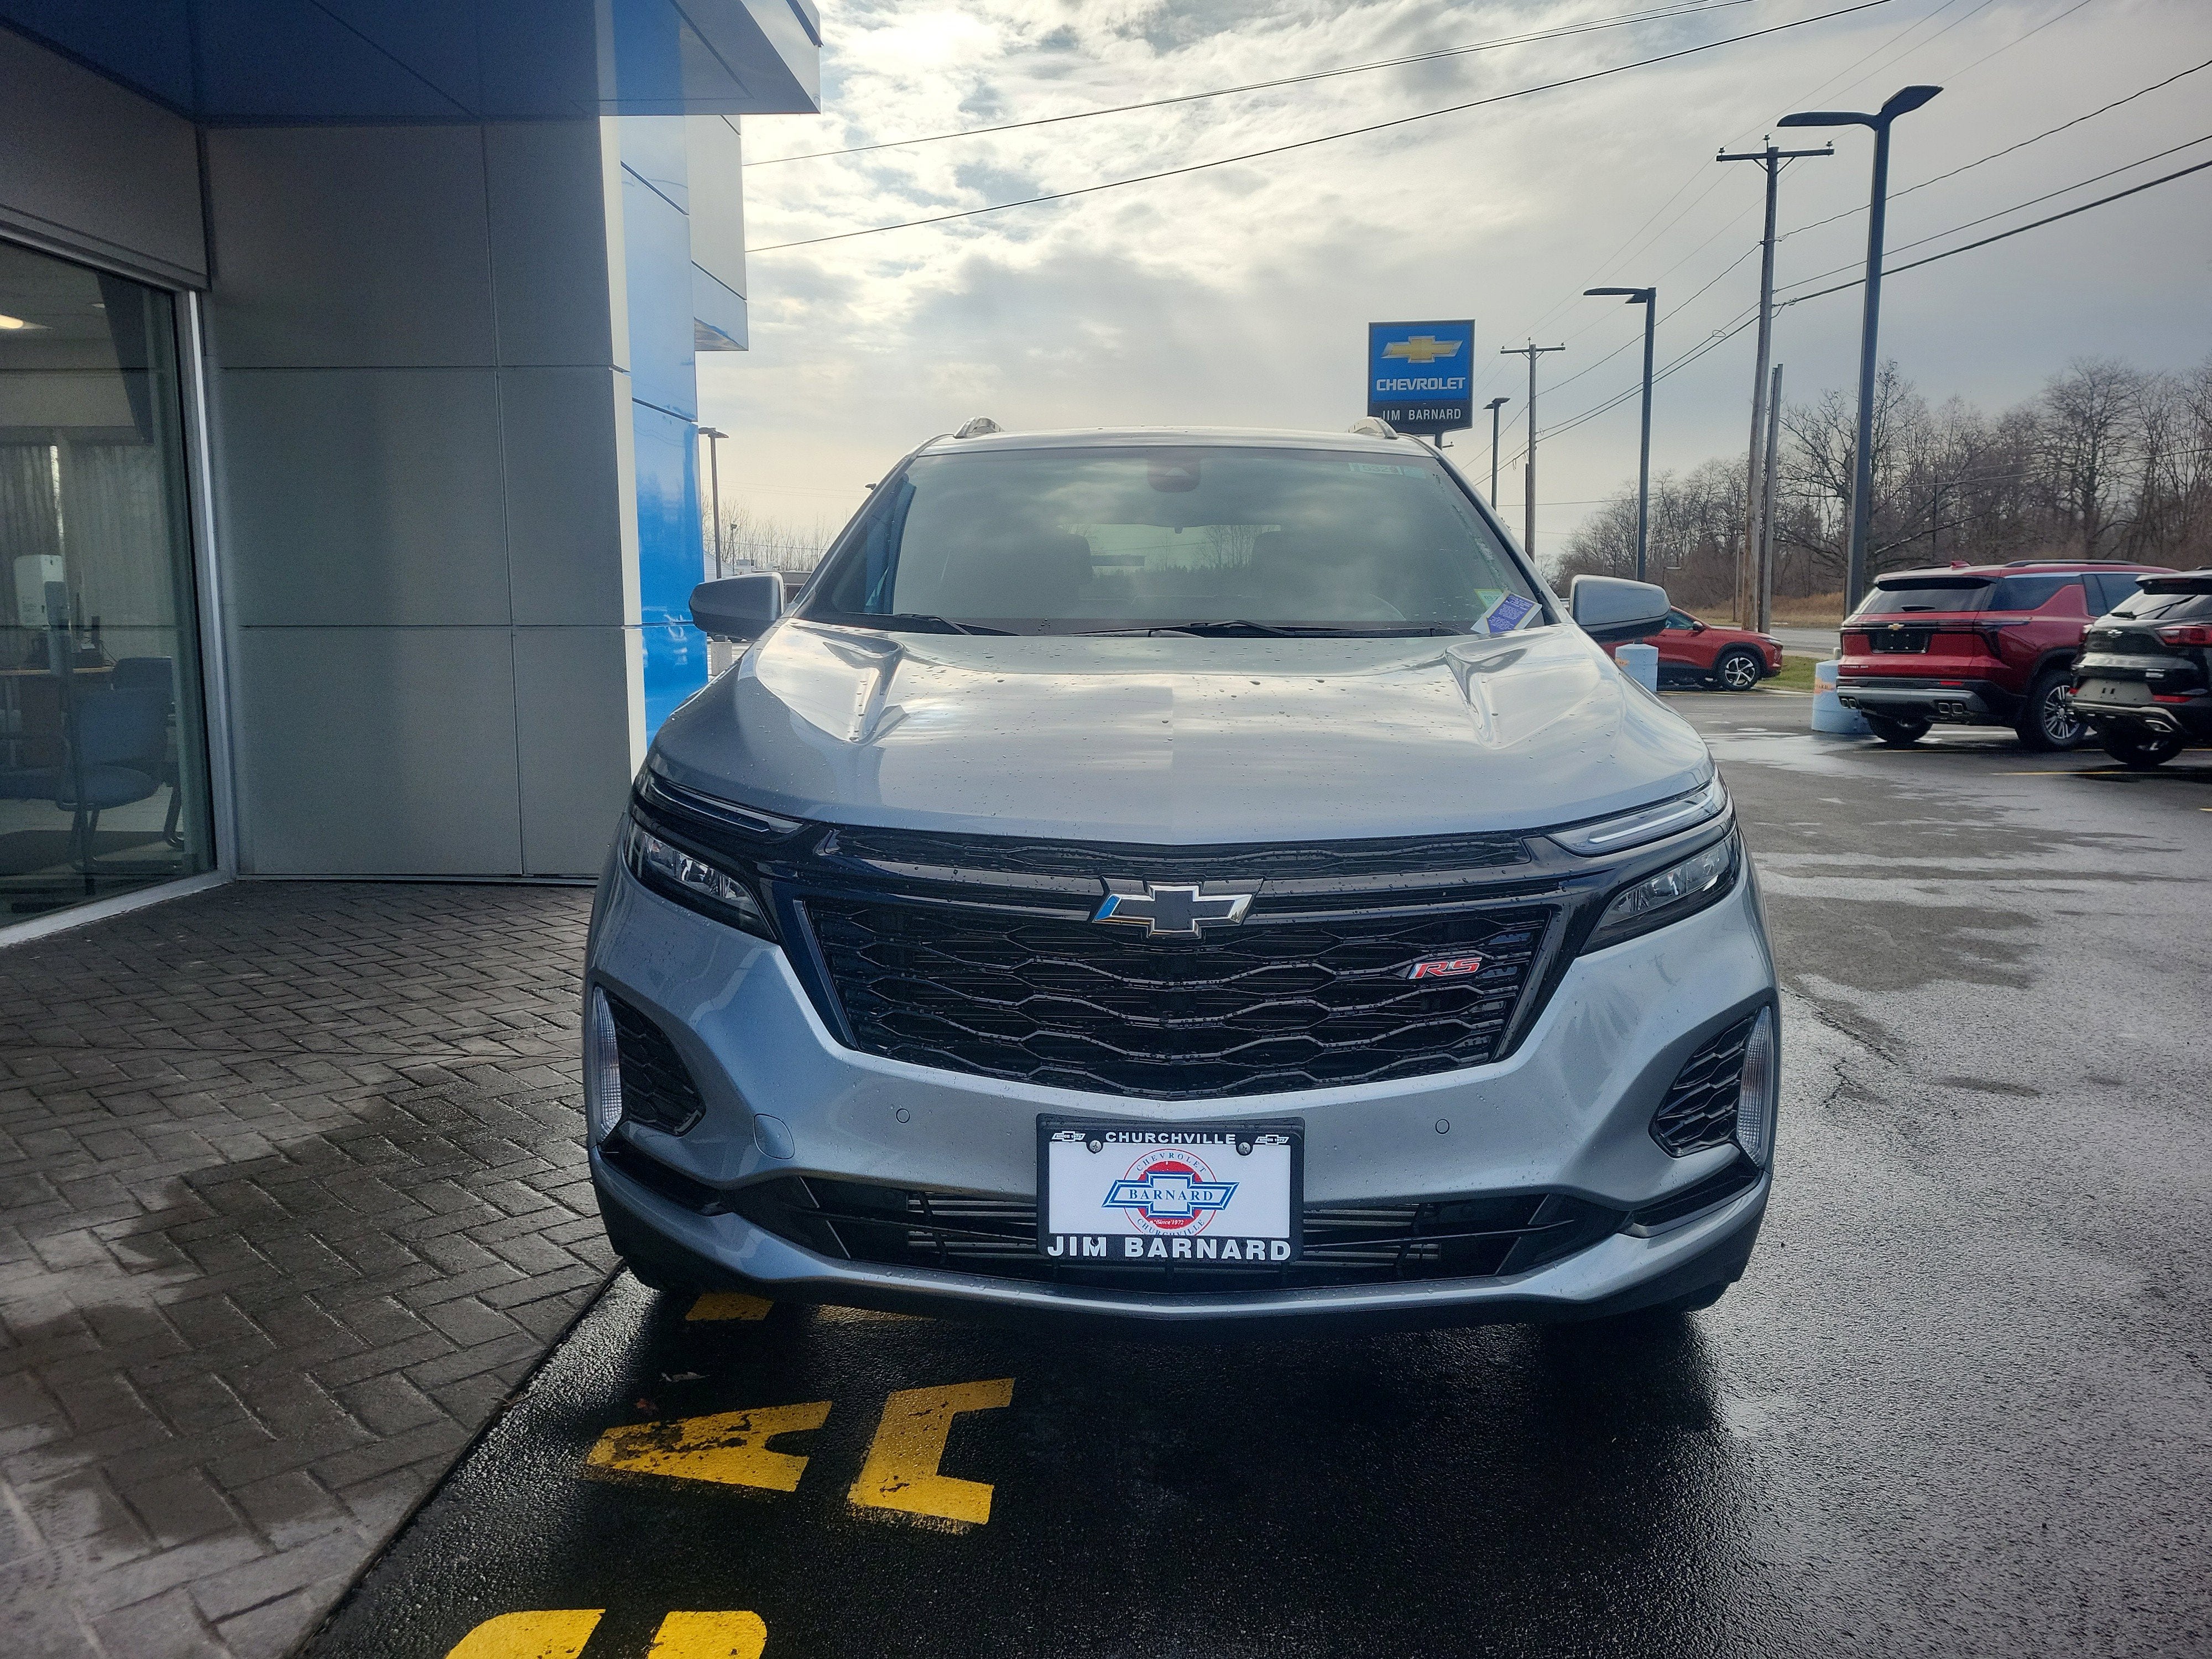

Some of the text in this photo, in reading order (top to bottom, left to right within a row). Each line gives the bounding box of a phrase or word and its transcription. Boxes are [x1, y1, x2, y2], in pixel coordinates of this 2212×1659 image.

[1376, 377, 1466, 391] CHEVROLET
[1381, 408, 1462, 421] JIM BARNARD
[1407, 957, 1483, 979] RS
[1105, 1131, 1236, 1144] CHURCHVILLE
[1136, 1152, 1206, 1173] CHEVROLET
[1129, 1188, 1214, 1201] BARNARD
[1047, 1237, 1291, 1261] JIM BARNARD
